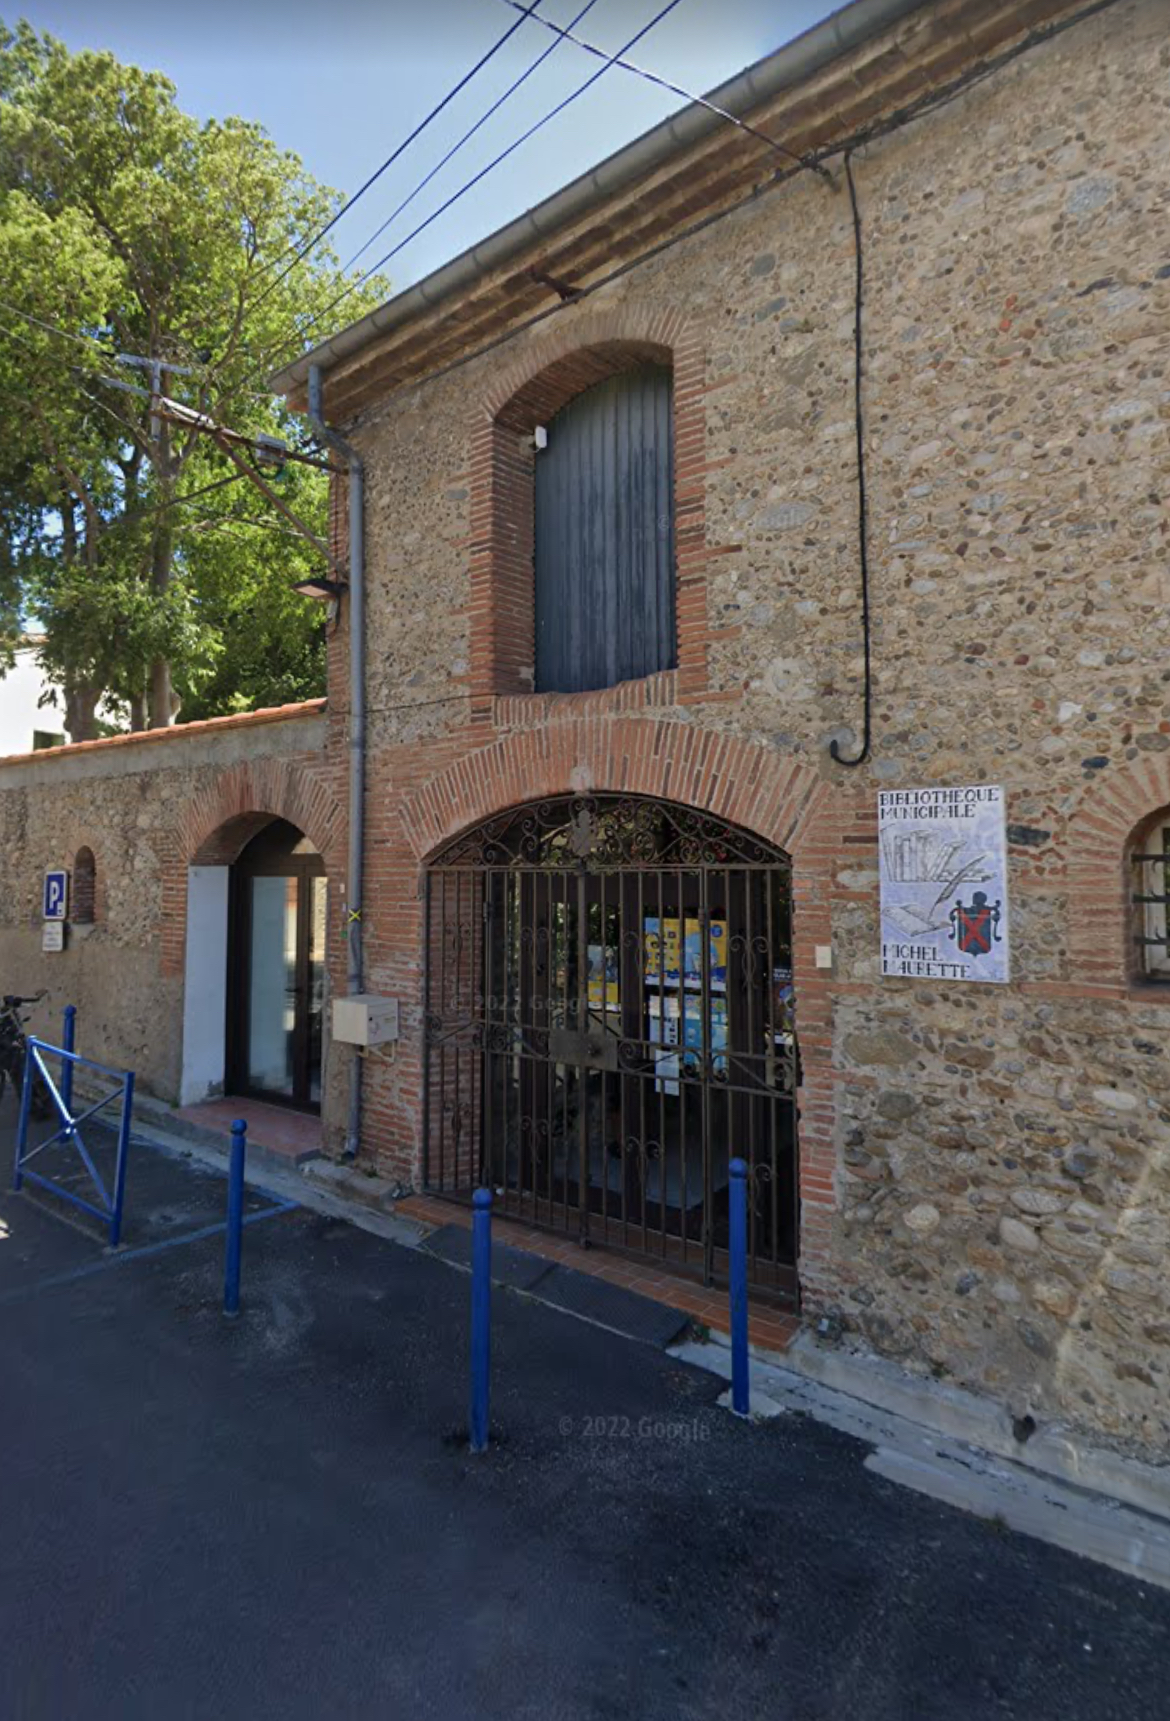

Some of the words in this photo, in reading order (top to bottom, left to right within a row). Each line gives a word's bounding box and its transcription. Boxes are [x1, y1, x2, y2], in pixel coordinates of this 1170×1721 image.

[880, 789, 999, 804] BIBLIOTHEQUE
[881, 804, 976, 820] MUNICIPALE
[49, 881, 60, 909] P
[883, 944, 943, 961] MICHEL
